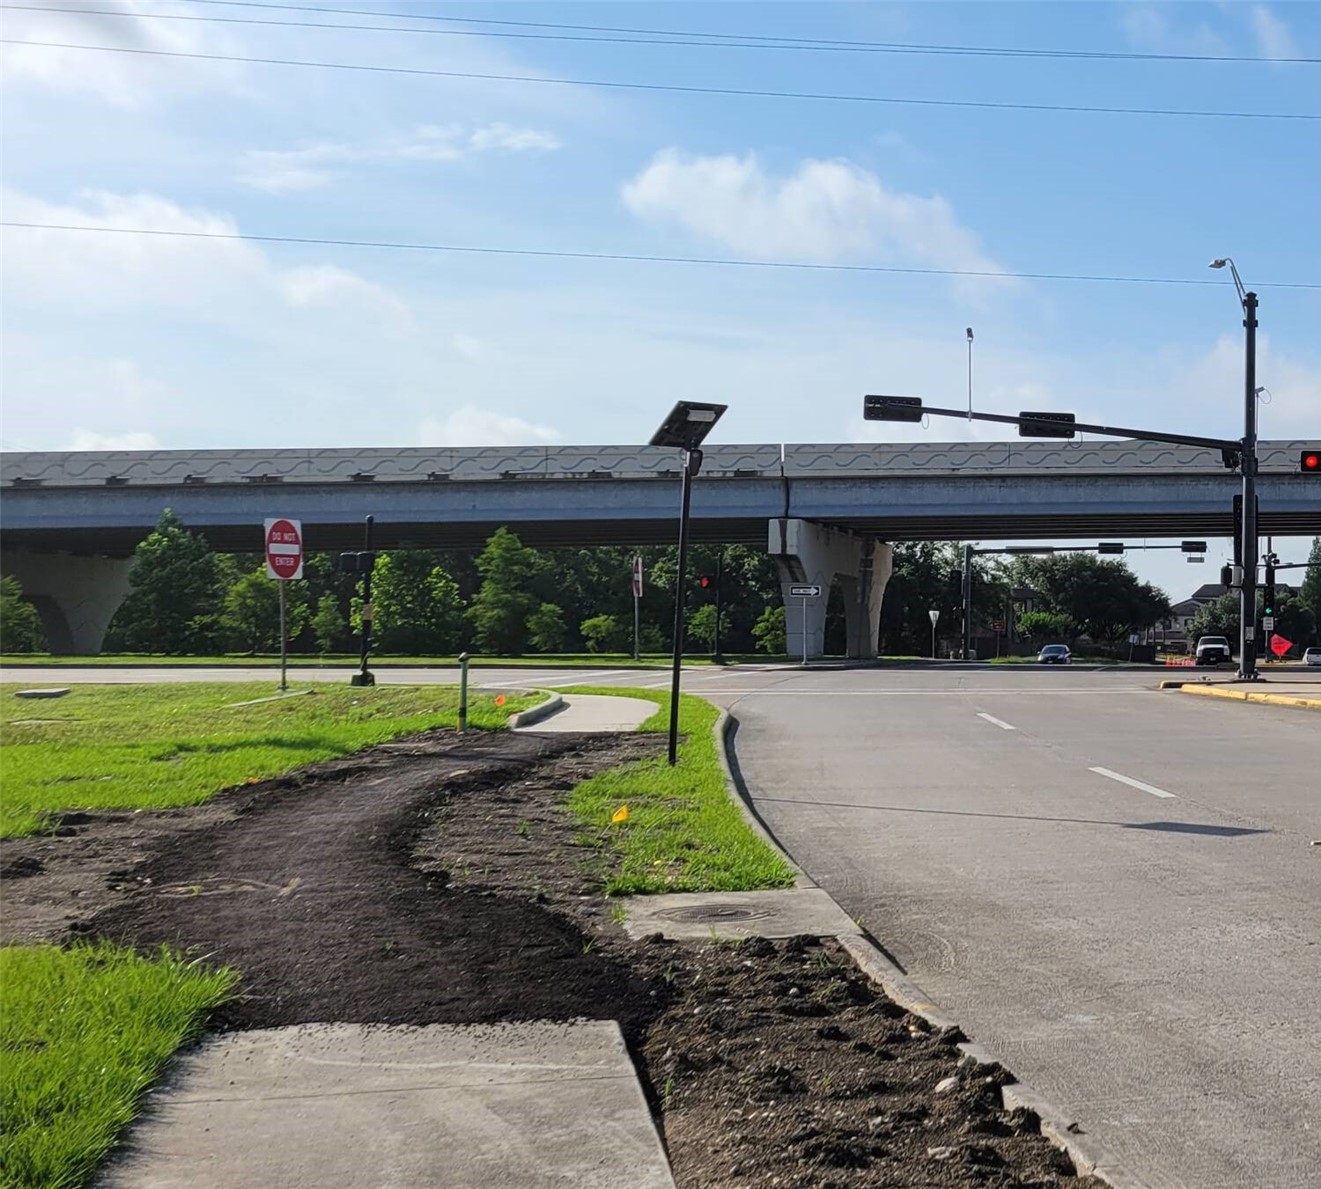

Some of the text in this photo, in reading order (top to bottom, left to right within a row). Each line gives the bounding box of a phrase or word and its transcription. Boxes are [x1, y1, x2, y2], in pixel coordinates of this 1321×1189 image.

[272, 531, 296, 541] DO NOT
[275, 556, 294, 566] ENTER
